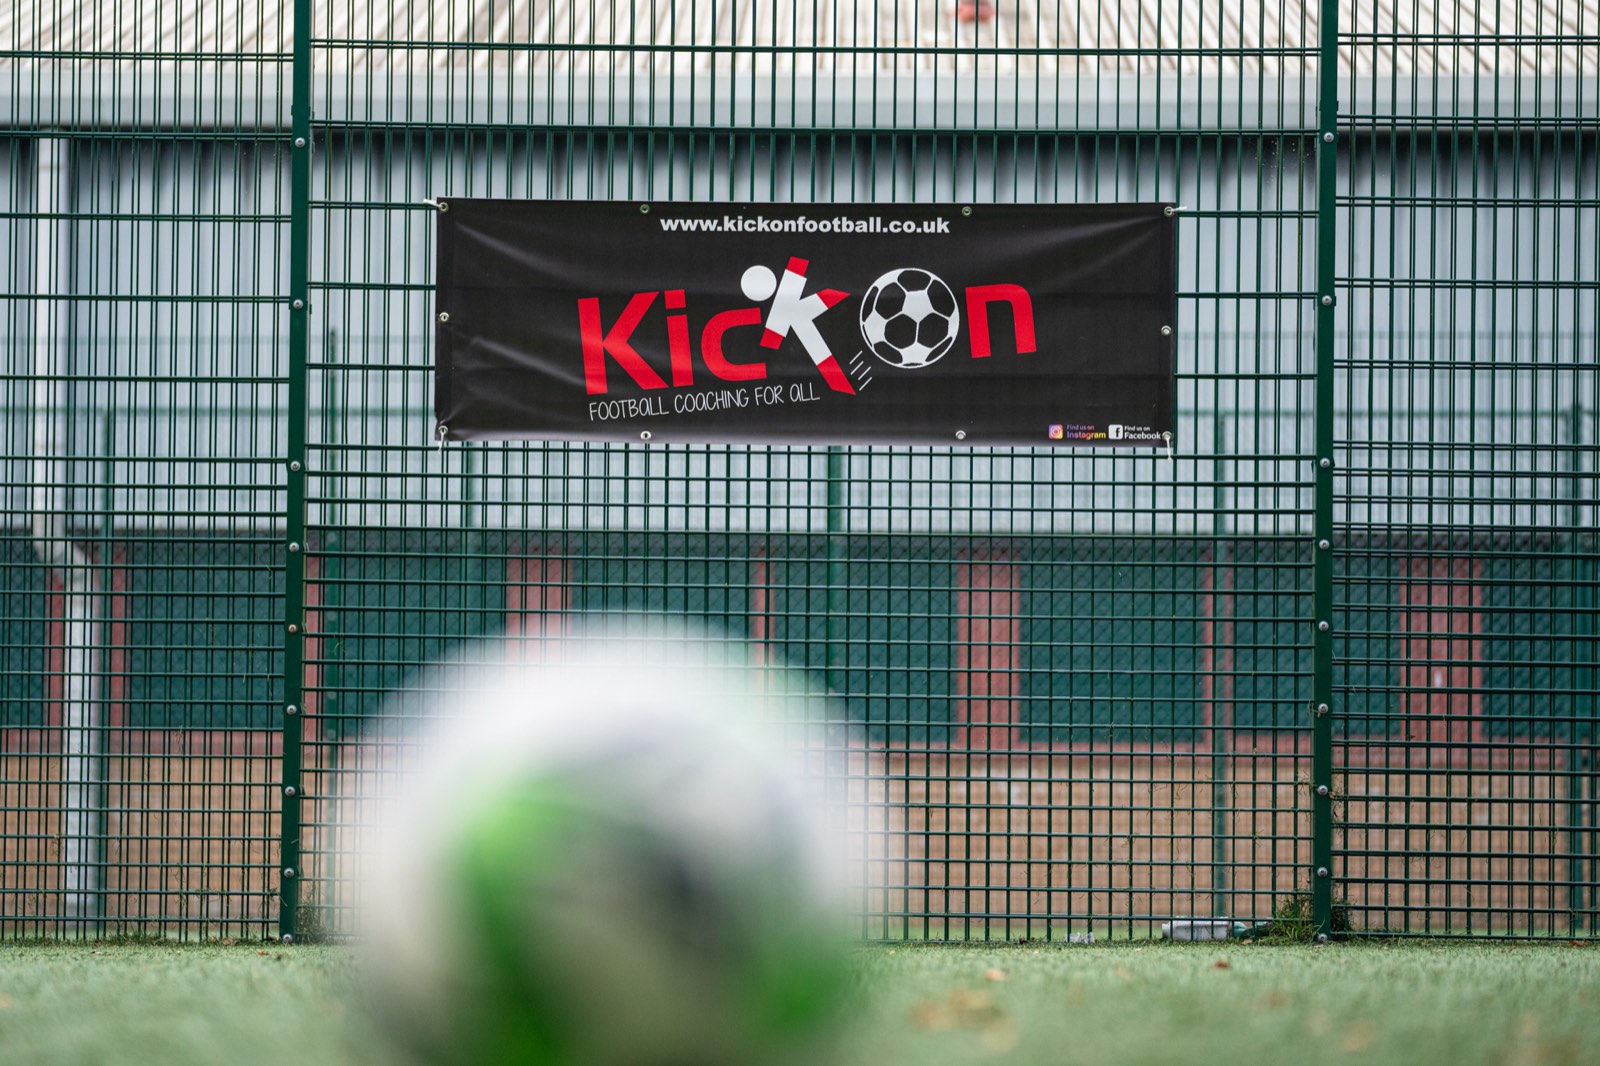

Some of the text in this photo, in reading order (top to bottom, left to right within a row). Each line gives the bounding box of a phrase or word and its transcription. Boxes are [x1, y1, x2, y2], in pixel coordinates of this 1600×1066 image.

[660, 215, 950, 233] www.kickonfootball.co.uk
[589, 382, 820, 421] FOOTBALL COACHING FOR ALL
[1067, 431, 1106, 440] Instagram
[1124, 431, 1161, 440] Facebook
